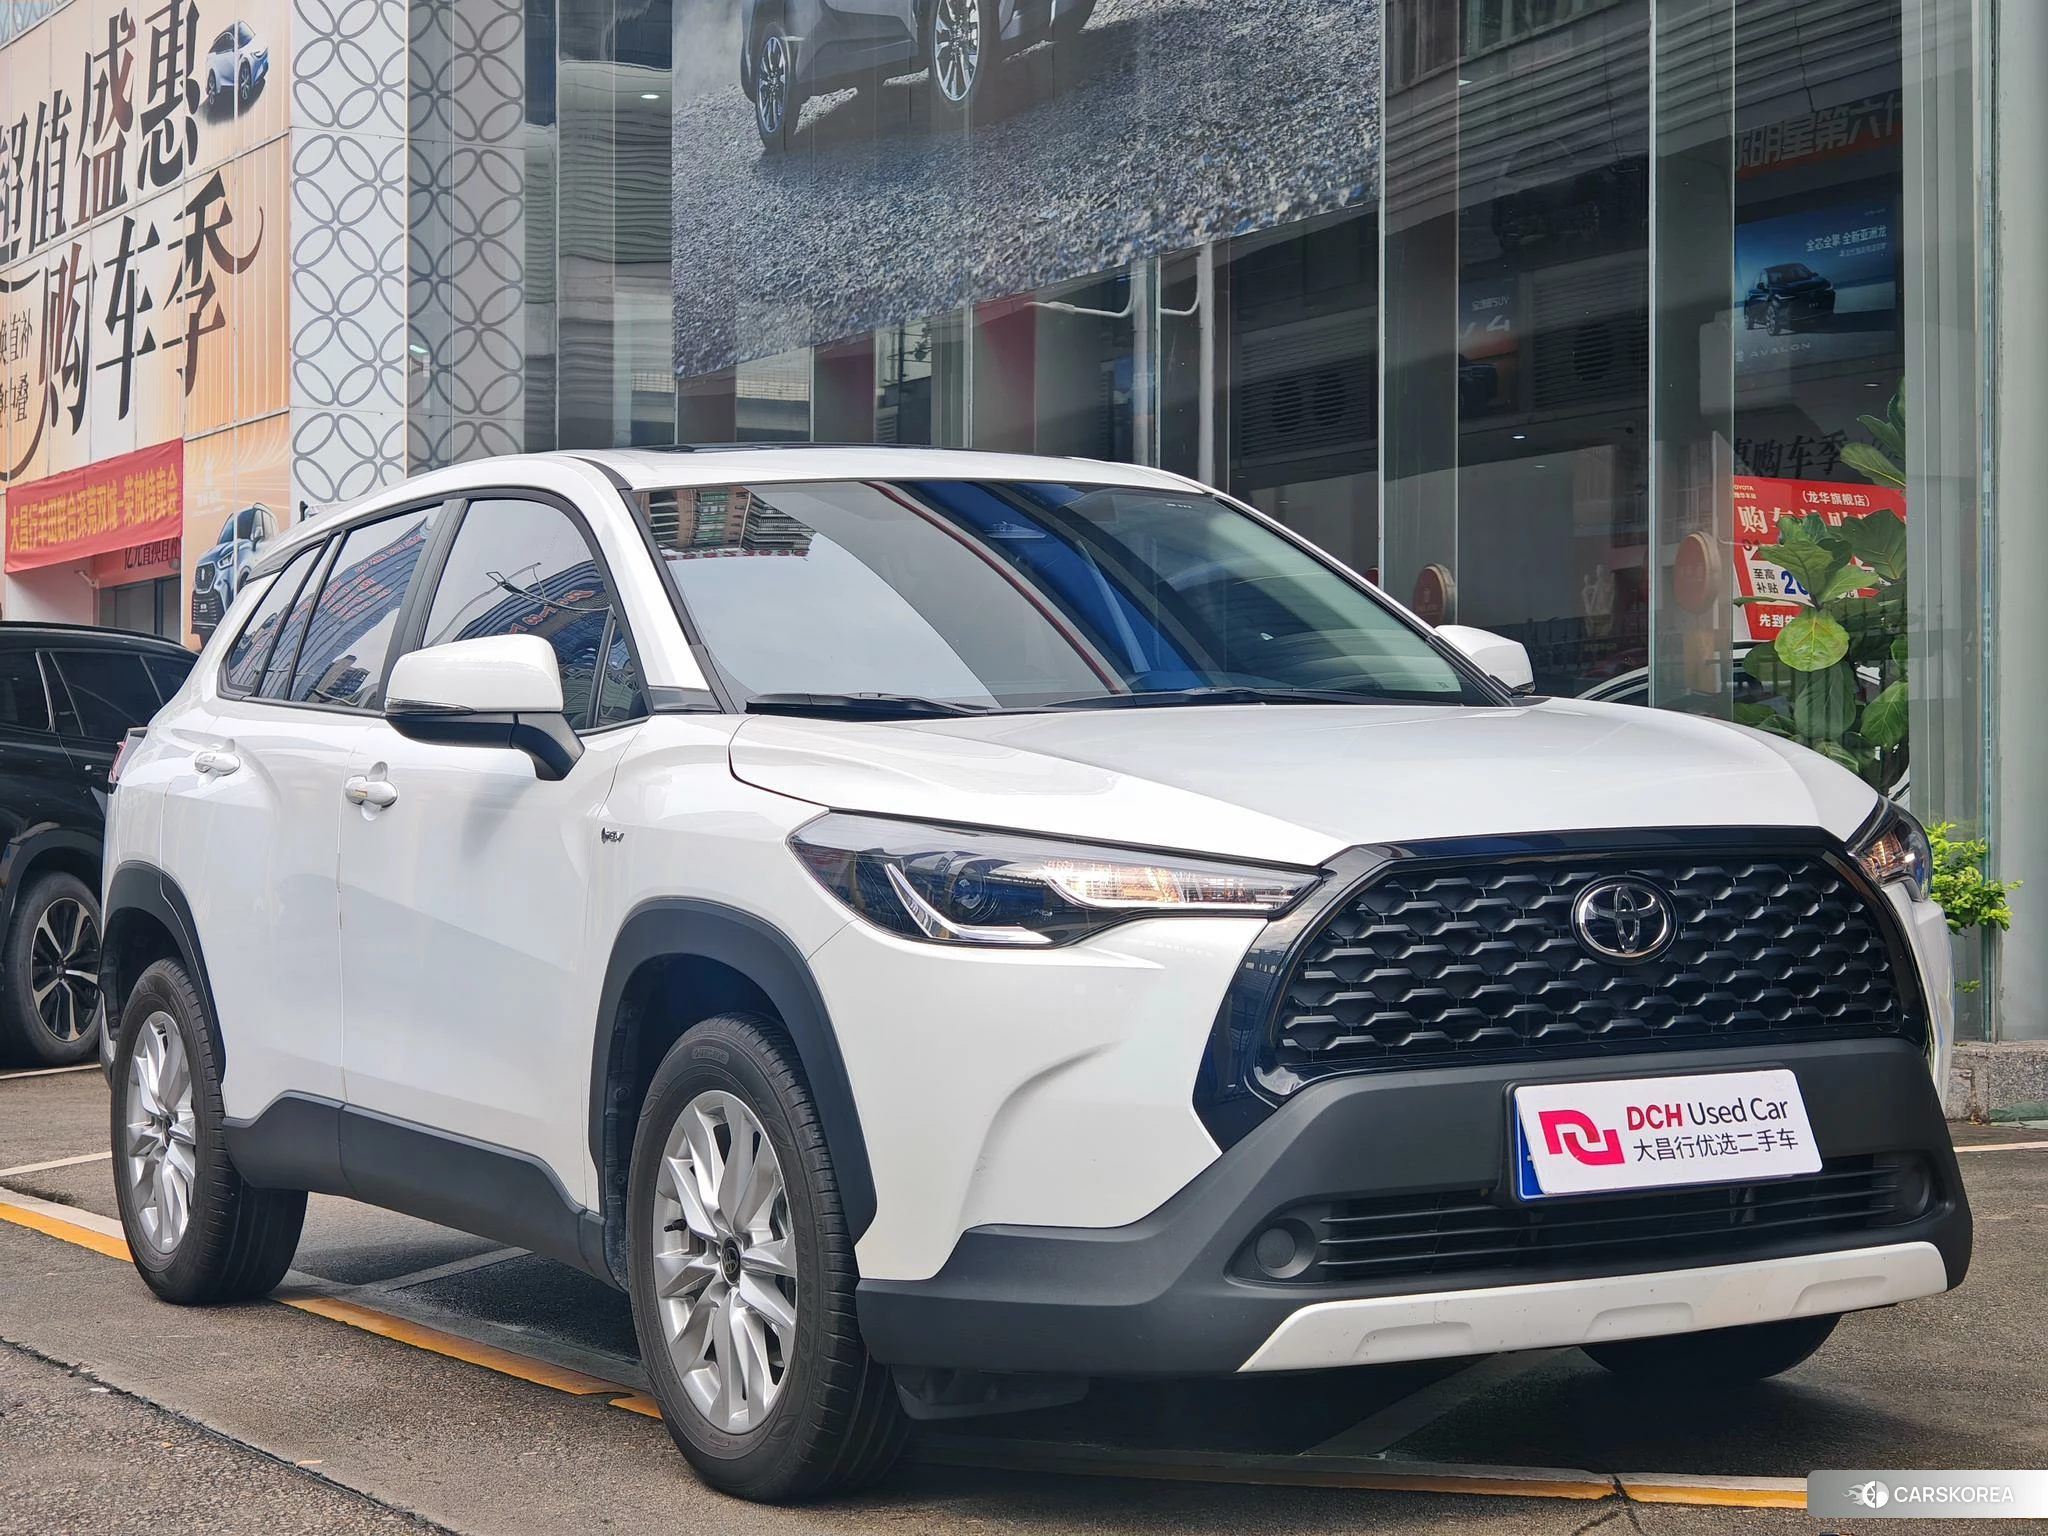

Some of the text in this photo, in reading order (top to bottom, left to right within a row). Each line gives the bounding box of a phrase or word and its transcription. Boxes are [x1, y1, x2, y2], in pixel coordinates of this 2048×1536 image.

[1753, 568, 1775, 580] 至高
[1756, 582, 1779, 594] 补贴
[1626, 1097, 1788, 1131] DCH Used Car
[1633, 1127, 1799, 1163] 大昌行优选二手车
